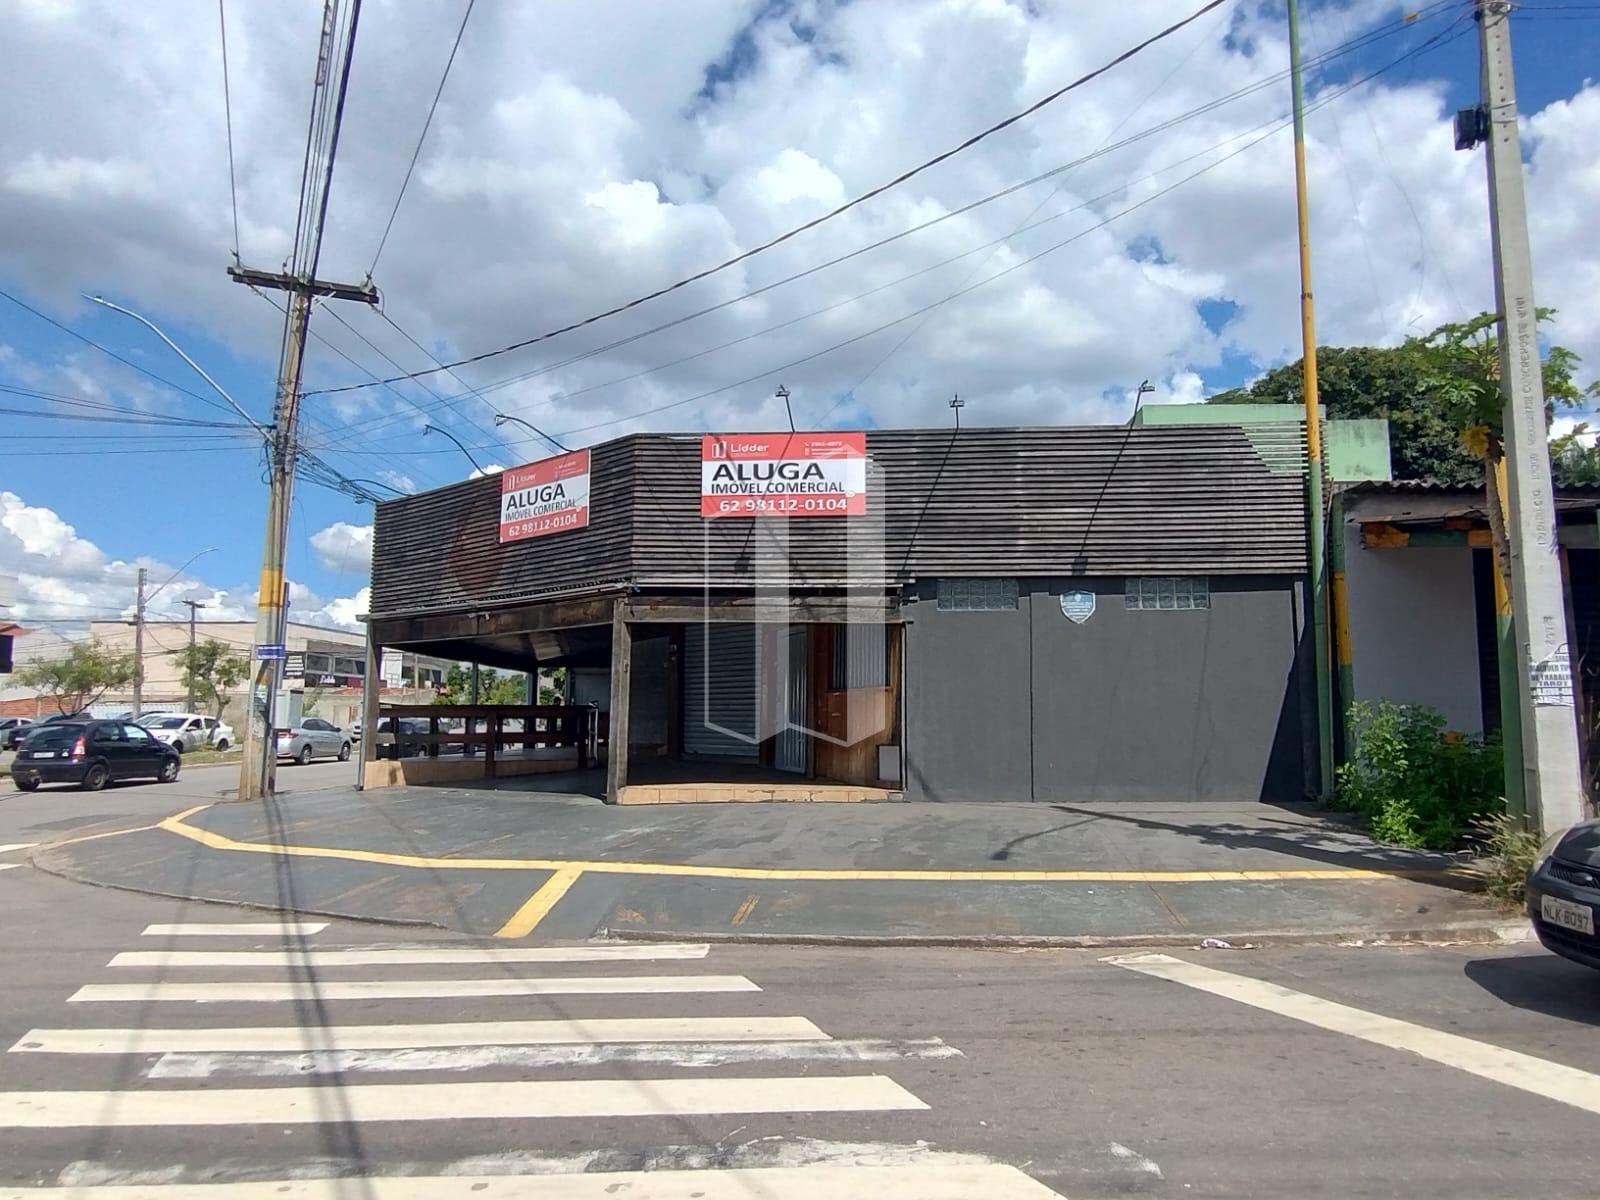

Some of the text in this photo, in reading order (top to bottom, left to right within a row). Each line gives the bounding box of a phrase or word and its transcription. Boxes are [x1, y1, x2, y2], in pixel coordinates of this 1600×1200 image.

[712, 463, 825, 481] ALUGA
[767, 482, 845, 493] COMERCIAL
[506, 483, 566, 511] ALUGA
[719, 499, 848, 512] 62 98112-0104
[533, 498, 577, 516] COMERCIAL
[509, 514, 577, 537] 62 98112-0104
